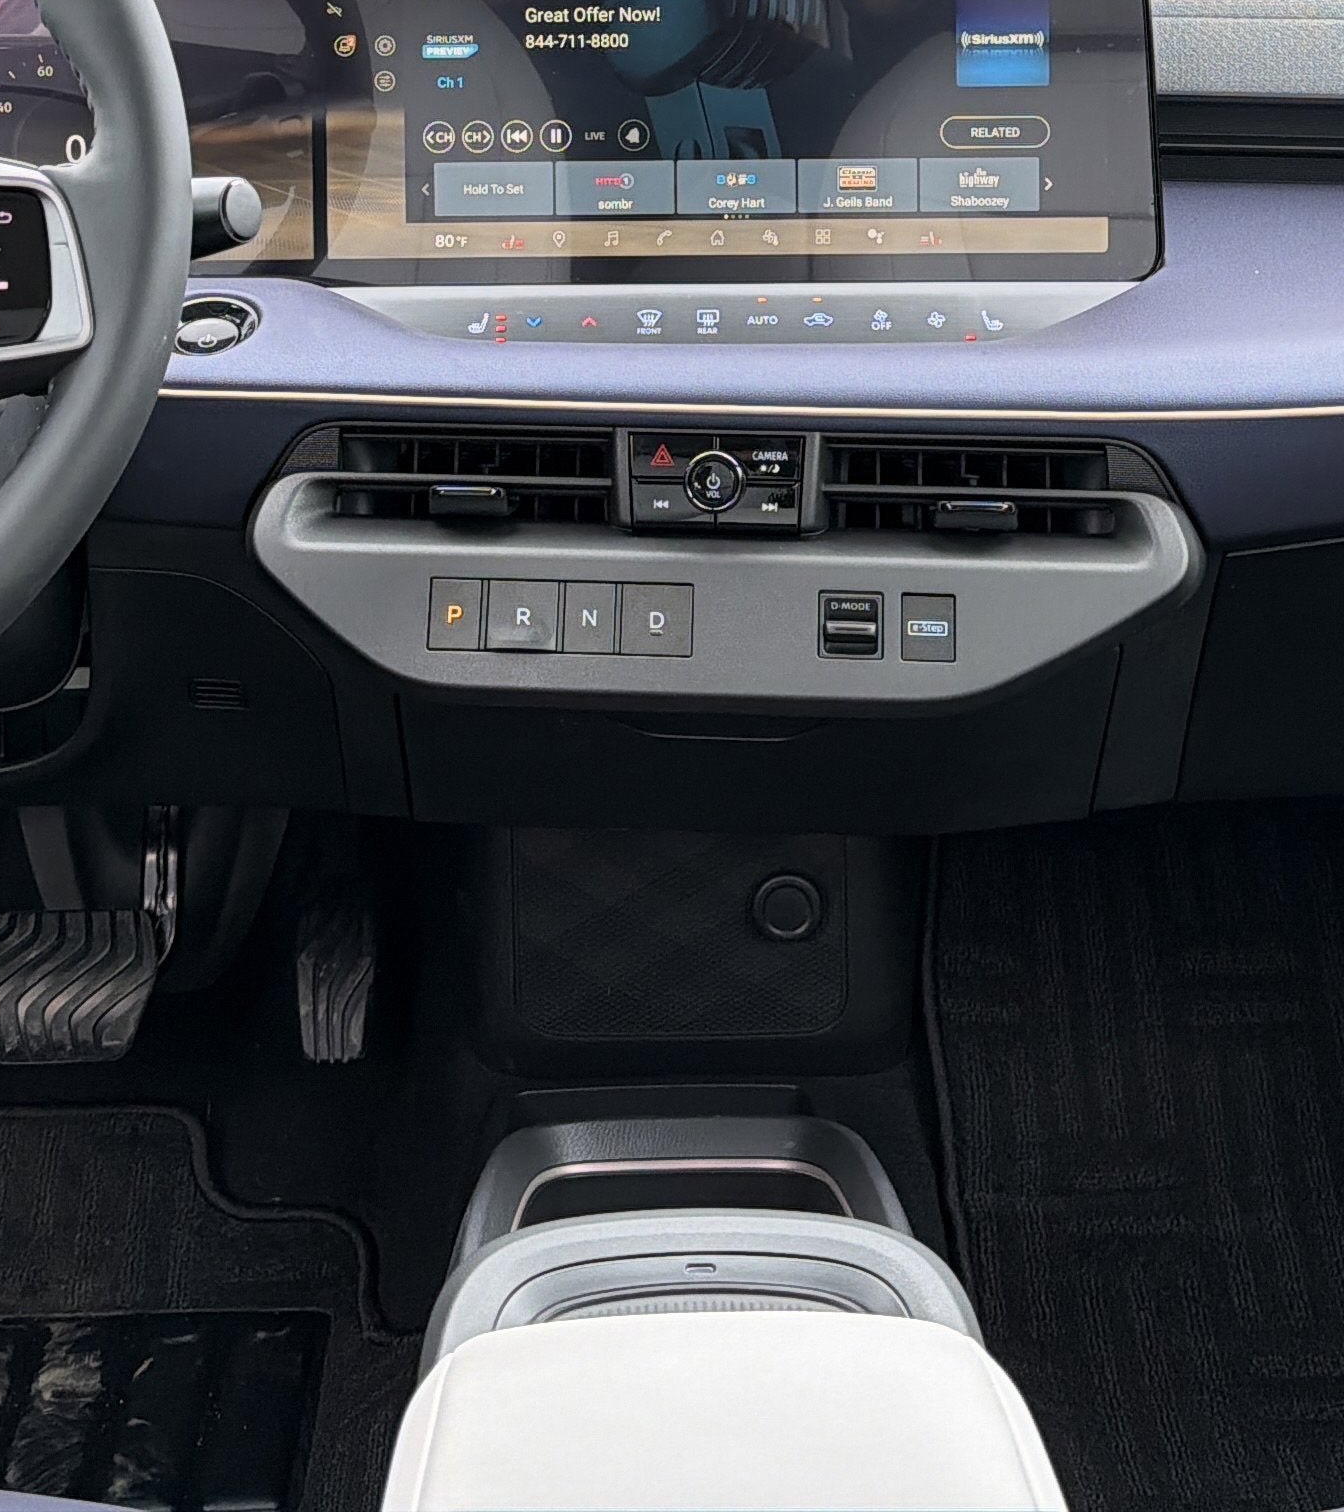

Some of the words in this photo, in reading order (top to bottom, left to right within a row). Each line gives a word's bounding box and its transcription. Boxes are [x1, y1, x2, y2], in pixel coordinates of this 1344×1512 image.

[525, 8, 569, 23] Great
[574, 7, 615, 22] Offer
[619, 7, 661, 22] Now!
[525, 34, 629, 48] 844-711-8800
[37, 66, 53, 77] 60
[437, 77, 454, 88] Ch
[457, 78, 464, 88] 1
[585, 132, 605, 140] LIVE
[971, 127, 1021, 138] RELATED
[65, 135, 87, 162] 0
[959, 172, 1000, 187] highway
[464, 184, 488, 195] Hold
[491, 184, 504, 195] To
[506, 184, 524, 195] Set
[598, 198, 633, 209] sombr
[708, 198, 738, 210] Corey
[742, 198, 765, 208] Hart
[824, 198, 834, 207] J.
[836, 197, 862, 207] Geils
[865, 196, 892, 207] Band
[951, 196, 1009, 208] Shaboozey
[747, 315, 778, 325] AUTO
[871, 321, 891, 331] OFF
[752, 451, 788, 460] CAMERA
[706, 491, 721, 499] VOL
[446, 605, 463, 625] P
[516, 608, 532, 625] R
[582, 610, 598, 626] N
[649, 612, 665, 629] D
[912, 622, 943, 633] e-Step
